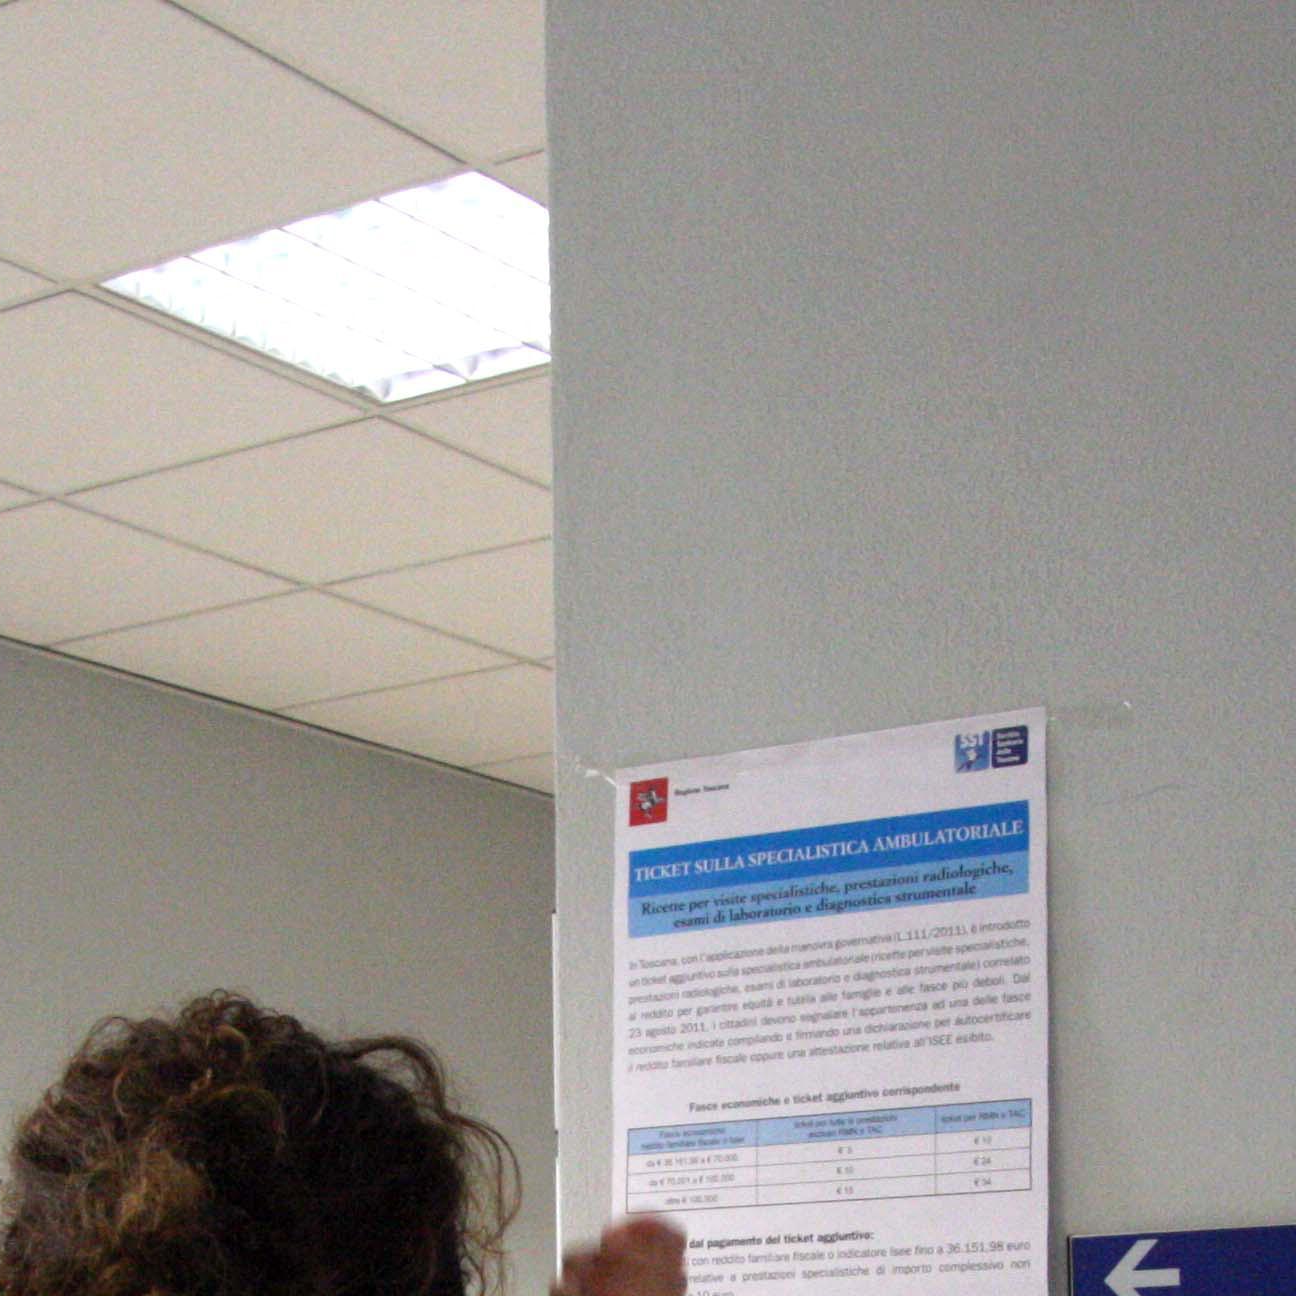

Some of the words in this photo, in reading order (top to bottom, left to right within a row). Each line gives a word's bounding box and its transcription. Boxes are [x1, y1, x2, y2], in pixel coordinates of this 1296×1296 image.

[636, 863, 690, 881] TICKET
[694, 855, 744, 873] SULLA
[748, 840, 869, 868] SPECIALISTICA
[874, 819, 1024, 851] AMBULATORIALE
[641, 898, 686, 916] Ricette
[688, 899, 709, 912] per
[713, 891, 746, 907] visite
[750, 879, 839, 905] specialistiche,
[844, 872, 919, 895] prestazioni
[923, 859, 1013, 886] radiologiche,
[673, 913, 709, 928] esami
[713, 909, 725, 923] di
[729, 901, 801, 922] laboratorio
[805, 904, 812, 913] e
[816, 890, 891, 915] diagnostica
[895, 881, 976, 903] strumentale
[689, 1100, 718, 1112] Fasce
[721, 1096, 781, 1110] economiche
[793, 1092, 823, 1104] ticket
[826, 1088, 879, 1104] aggiuntivo
[689, 1239, 704, 1249] dal
[707, 1236, 762, 1250] pagamento
[765, 1235, 781, 1244] del
[784, 1233, 814, 1244] ticket
[817, 1230, 873, 1244] aggiuntivo:
